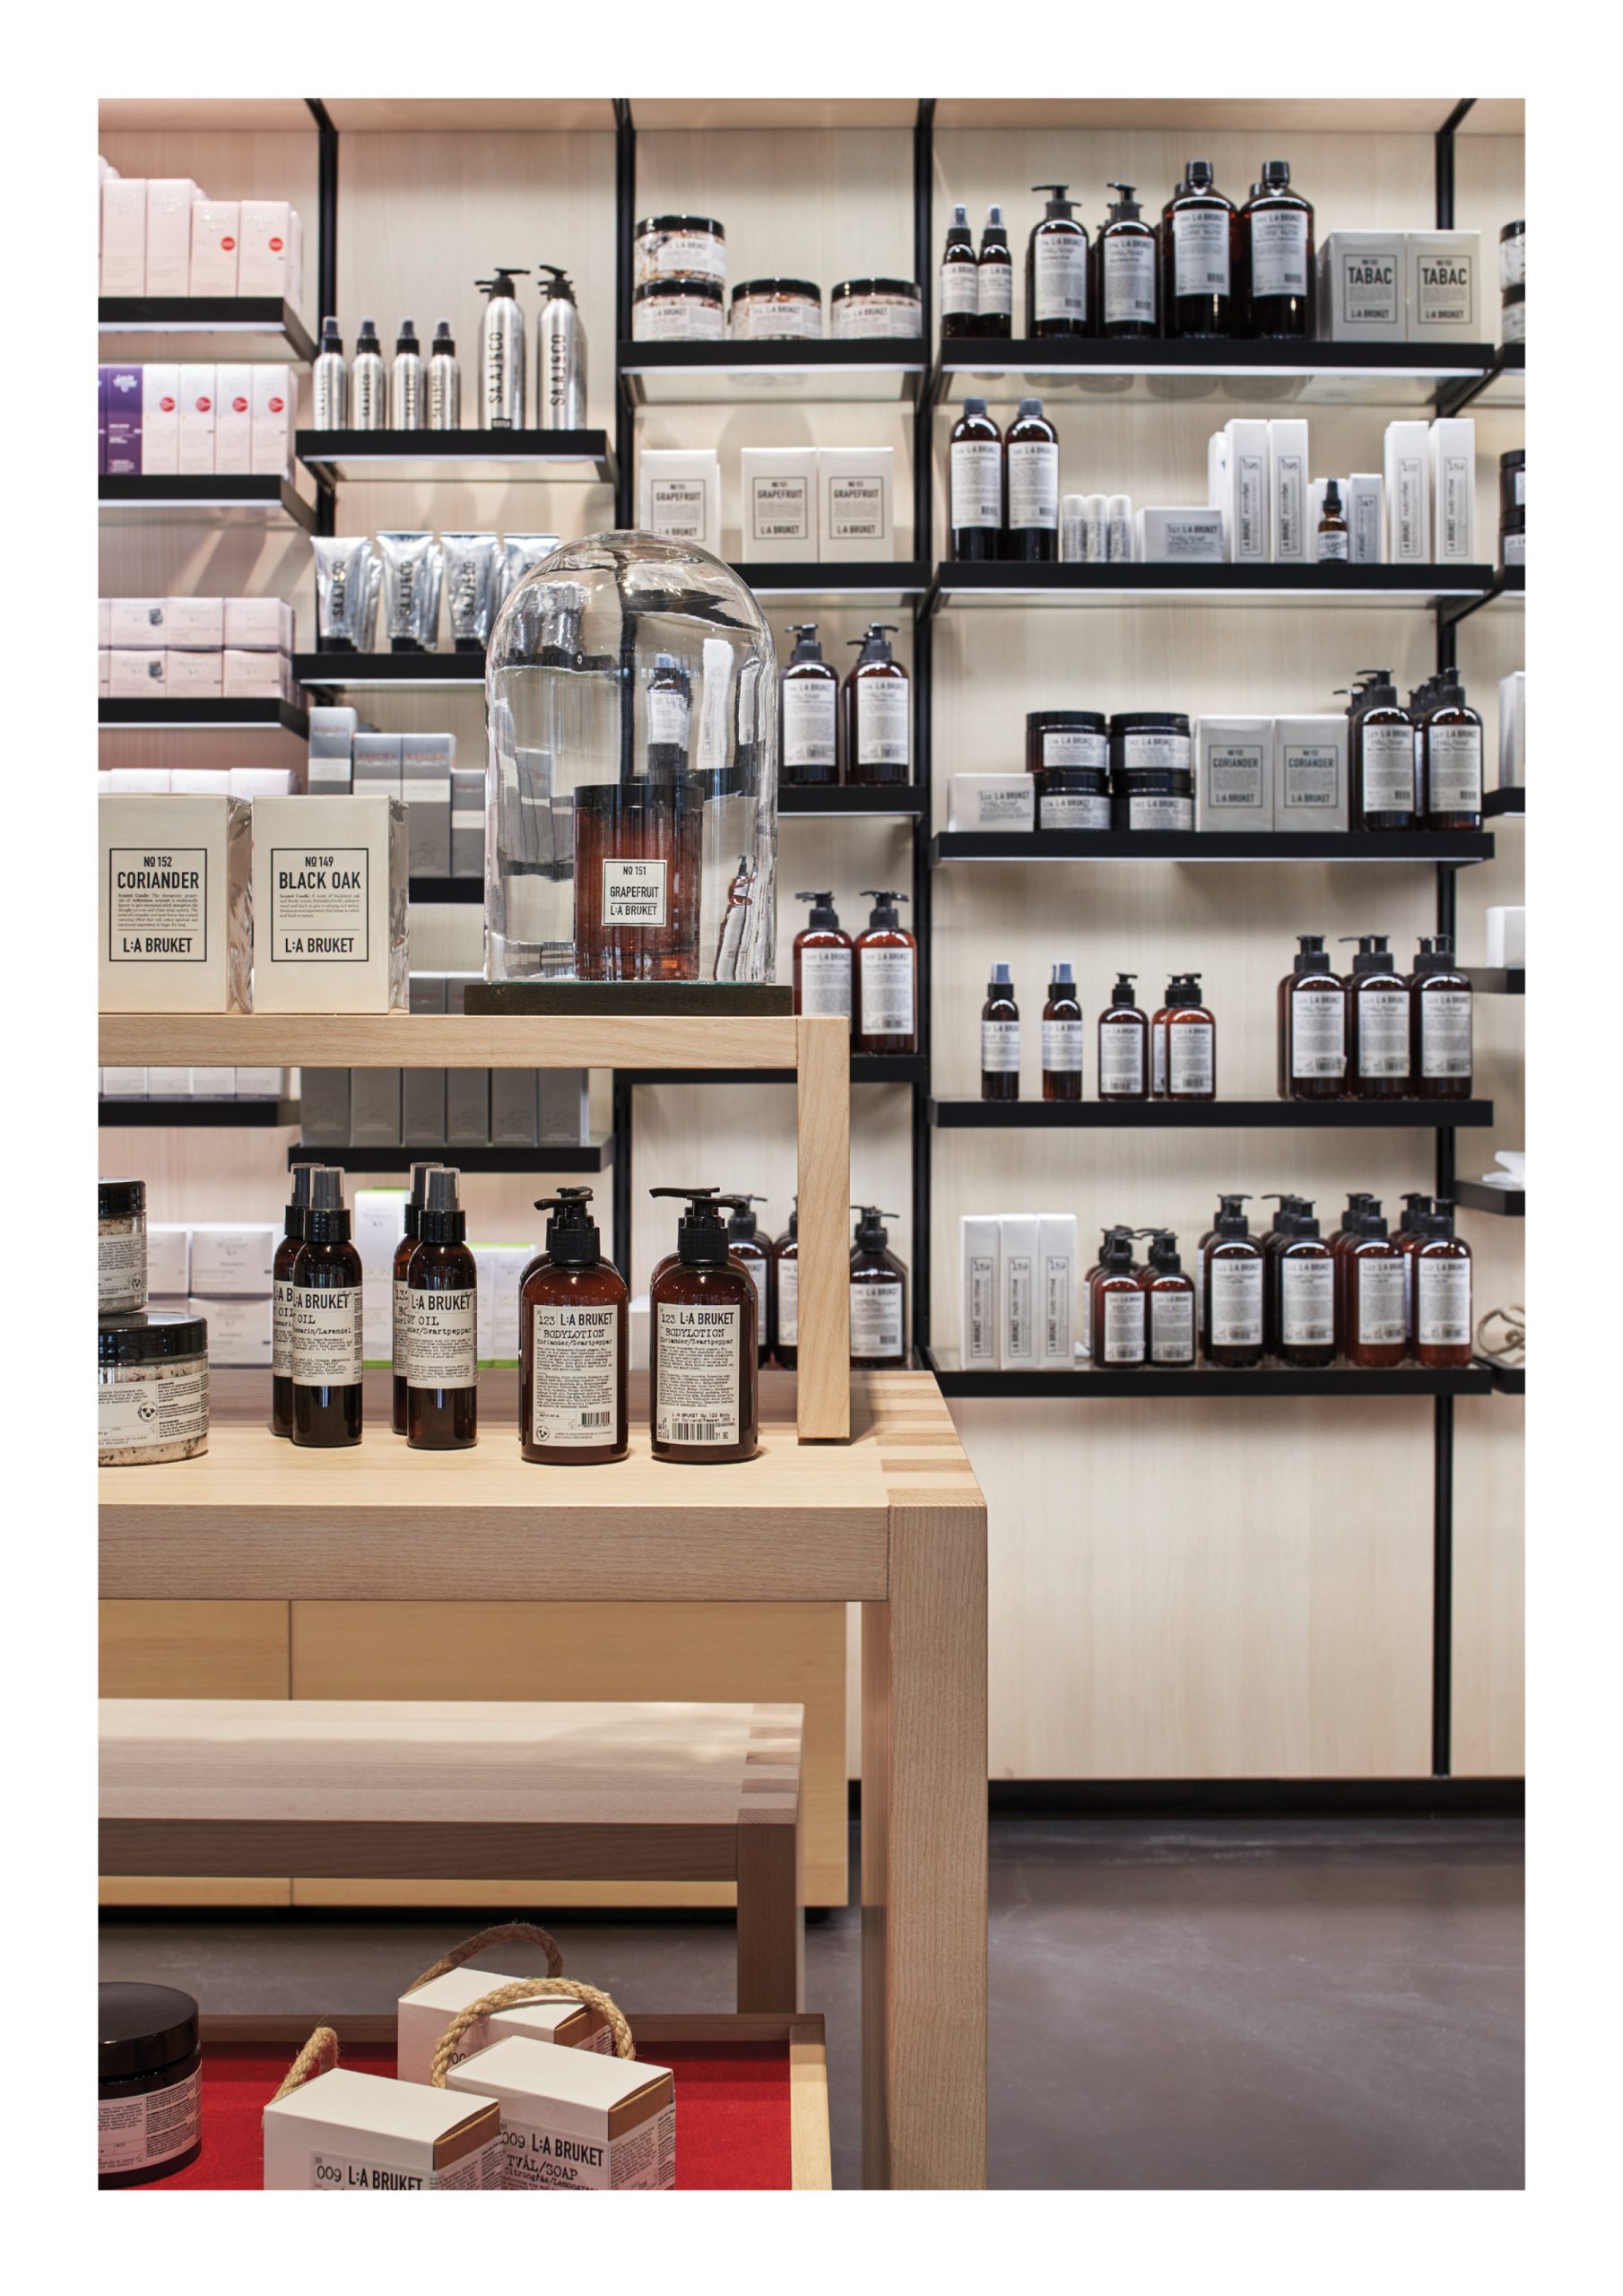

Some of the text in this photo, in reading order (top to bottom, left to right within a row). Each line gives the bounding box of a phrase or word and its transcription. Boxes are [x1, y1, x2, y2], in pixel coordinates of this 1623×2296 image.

[1348, 267, 1393, 284] TABAC
[1422, 268, 1467, 285] TABAC
[655, 491, 701, 501] GRAPEFRUIT
[758, 489, 803, 499] GRAPEFRUIT
[834, 489, 879, 499] GRAPEFRUIT
[1212, 758, 1259, 768] CORIANDER
[1288, 758, 1334, 768] CORIANDER
[158, 857, 172, 867] 152
[319, 857, 334, 867] 149
[635, 866, 647, 875] 151
[117, 872, 199, 889] CORIANDER
[279, 872, 360, 889] BLACK OAK
[610, 886, 659, 898] GRAPEFRUIT
[611, 905, 657, 916] L:A BRUKET
[123, 937, 193, 952] L:A BRUKET
[285, 937, 354, 952] L:A BRUKET
[305, 1293, 350, 1309] BRUKET
[412, 1294, 471, 1310] L:A BRUKET
[298, 1314, 316, 1325] OIL
[419, 1317, 439, 1326] OIL
[539, 1312, 613, 1326] 123 L:A BRUKET
[662, 1312, 734, 1325] 123 L:A BRUKET
[543, 1329, 605, 1339] BODYLOTION
[665, 1328, 725, 1338] BODYLOTION
[532, 2134, 551, 2155] L:A
[555, 2139, 603, 2167] BRUKET
[508, 2154, 577, 2180] TVÅL/SOAP
[317, 2165, 423, 2190] 009 L:A BRUKET
